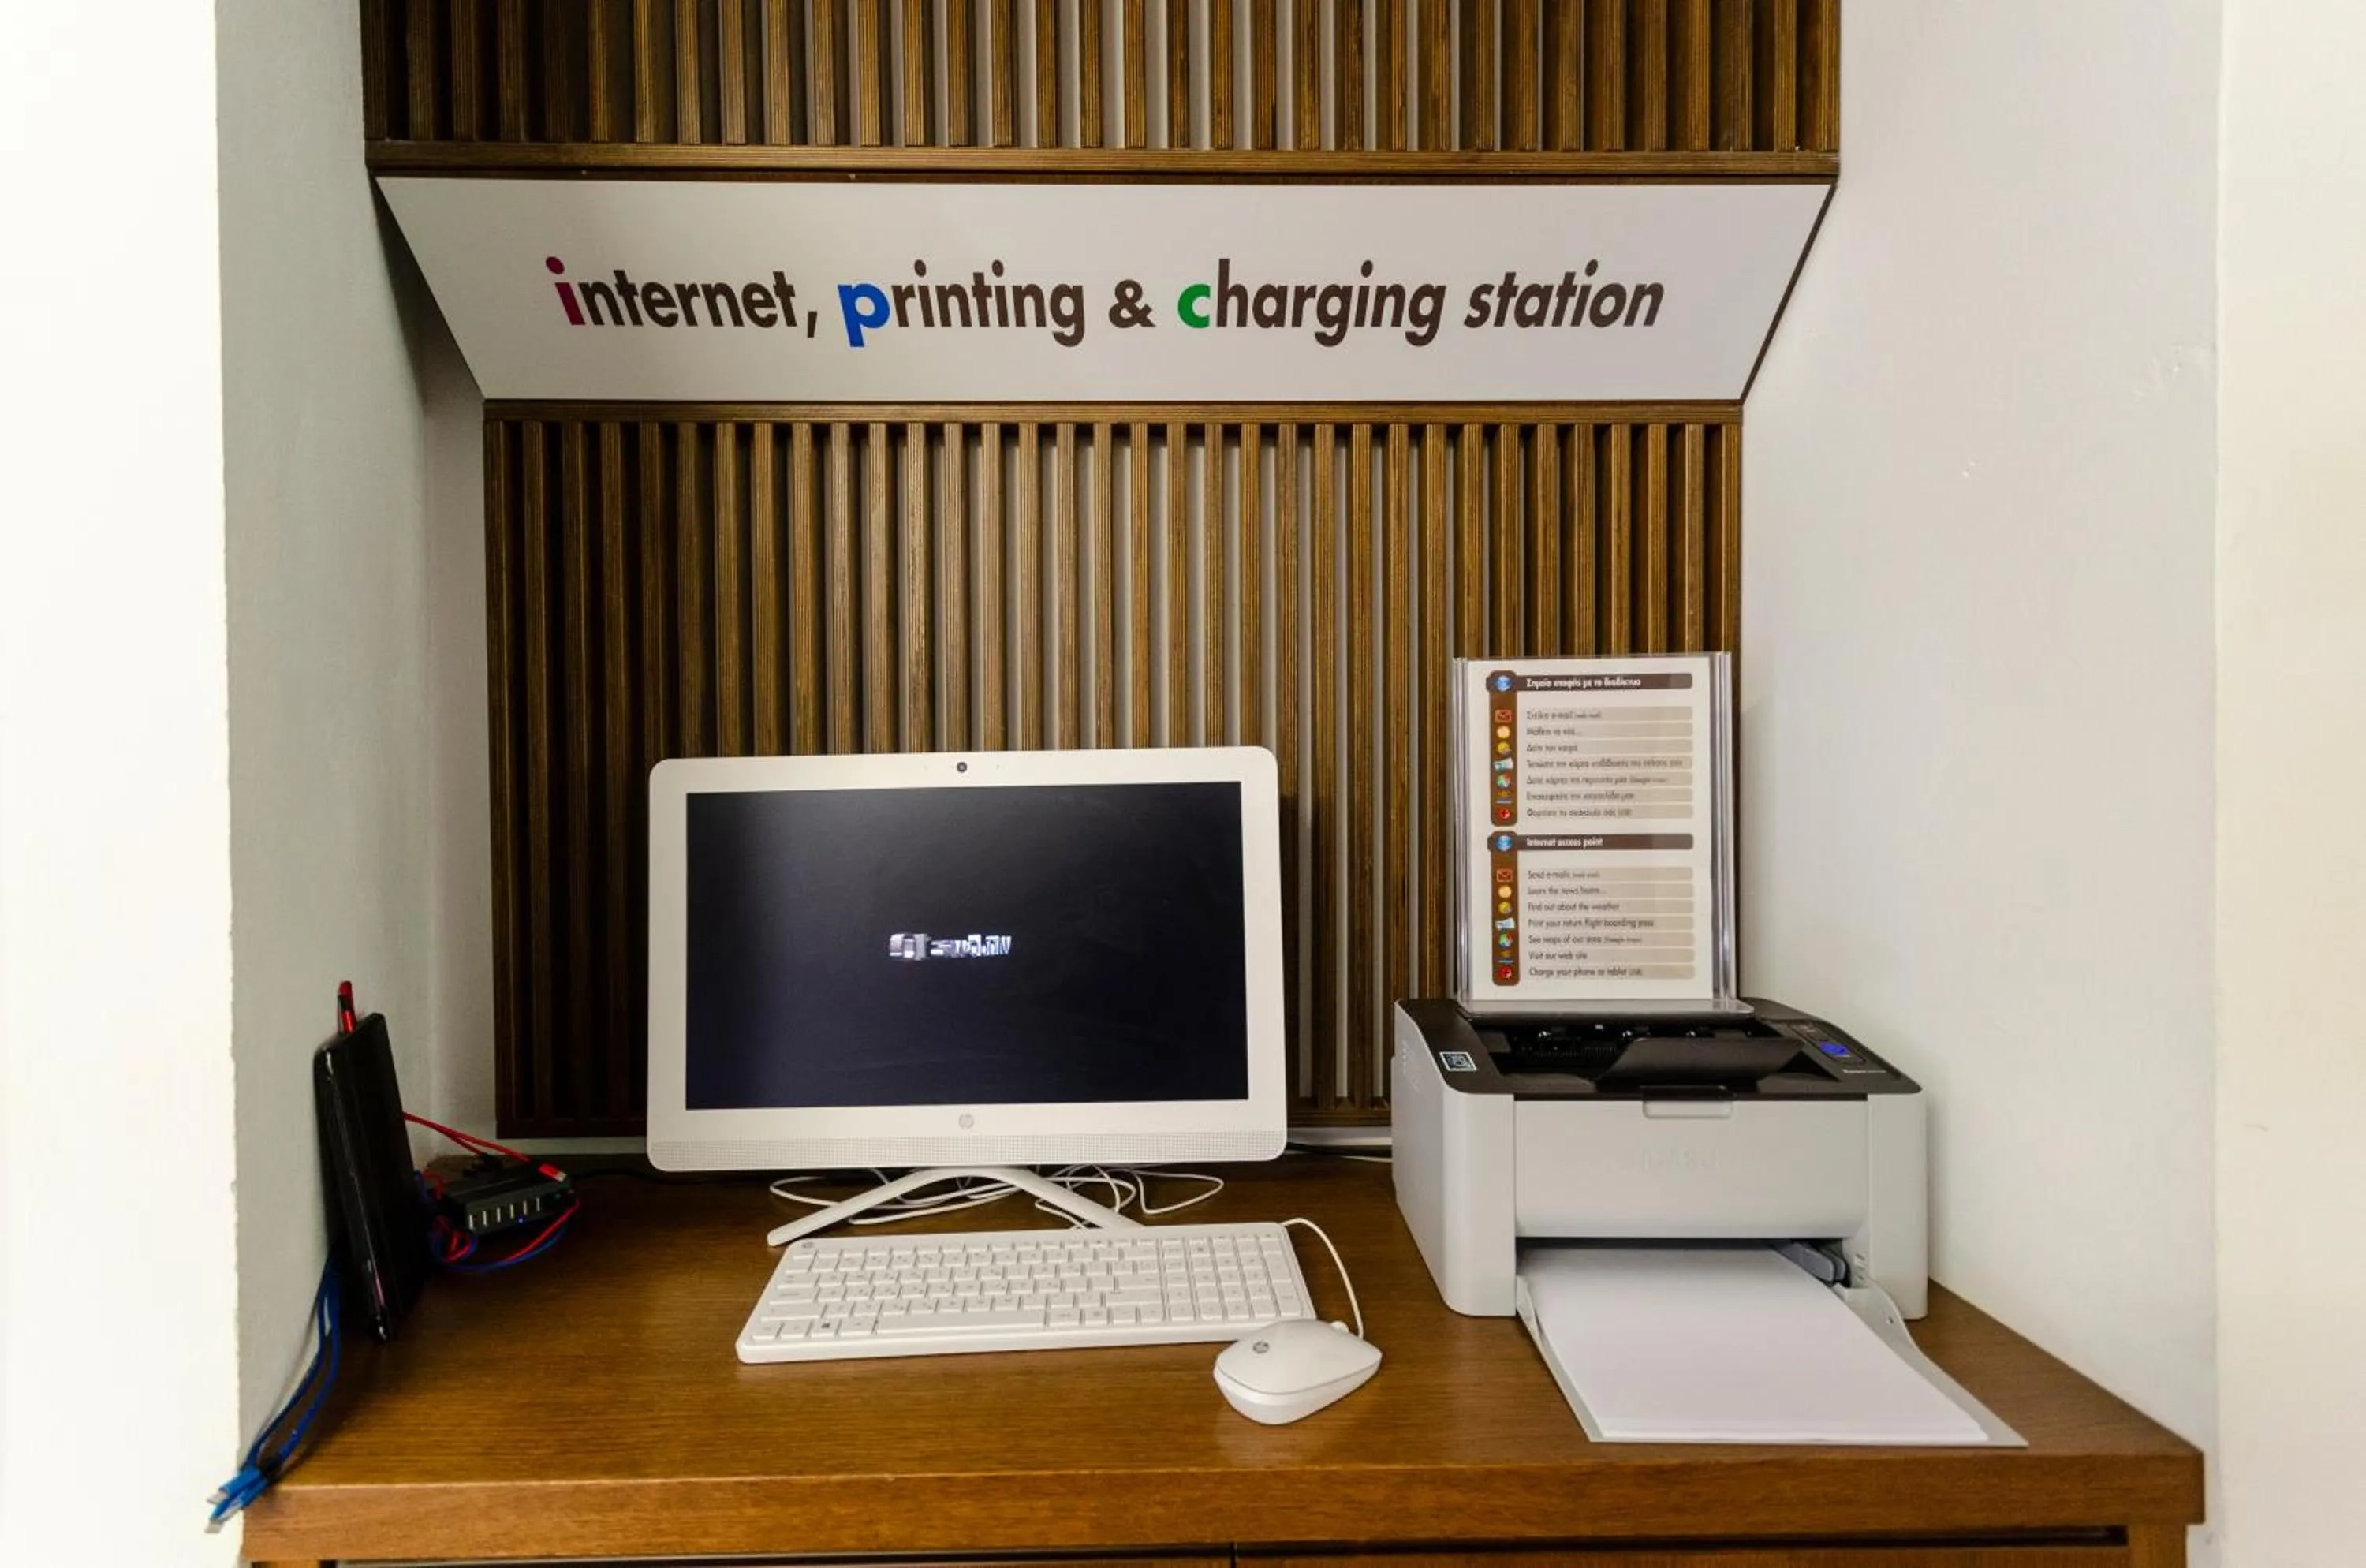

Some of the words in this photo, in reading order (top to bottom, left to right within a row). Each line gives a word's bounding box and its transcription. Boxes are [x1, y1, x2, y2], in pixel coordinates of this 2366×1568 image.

[546, 256, 817, 338] internet,
[837, 259, 1084, 349] printing
[1110, 280, 1154, 328] &
[1178, 259, 1446, 349] charging
[1463, 260, 1664, 328] station
[1527, 837, 1555, 846] Internet
[1583, 837, 1603, 849] point
[1528, 870, 1545, 879] Send
[1547, 870, 1571, 879] e-mail
[1528, 902, 1542, 911] Find
[1543, 902, 1555, 911] out
[1557, 902, 1577, 911] about
[1592, 902, 1620, 911] weather
[1528, 919, 1544, 928] Print
[1546, 920, 1561, 929] your
[1603, 917, 1636, 928] boarding
[1638, 920, 1655, 928] pass
[1528, 935, 1541, 944] See
[1543, 937, 1561, 946] maps
[1563, 935, 1572, 944] of
[1528, 951, 1543, 960] Visit
[1558, 951, 1573, 960] web
[1529, 968, 1554, 978] Charge
[1556, 969, 1571, 978] your
[1573, 968, 1595, 978] phone
[1607, 967, 1627, 976] tablet
